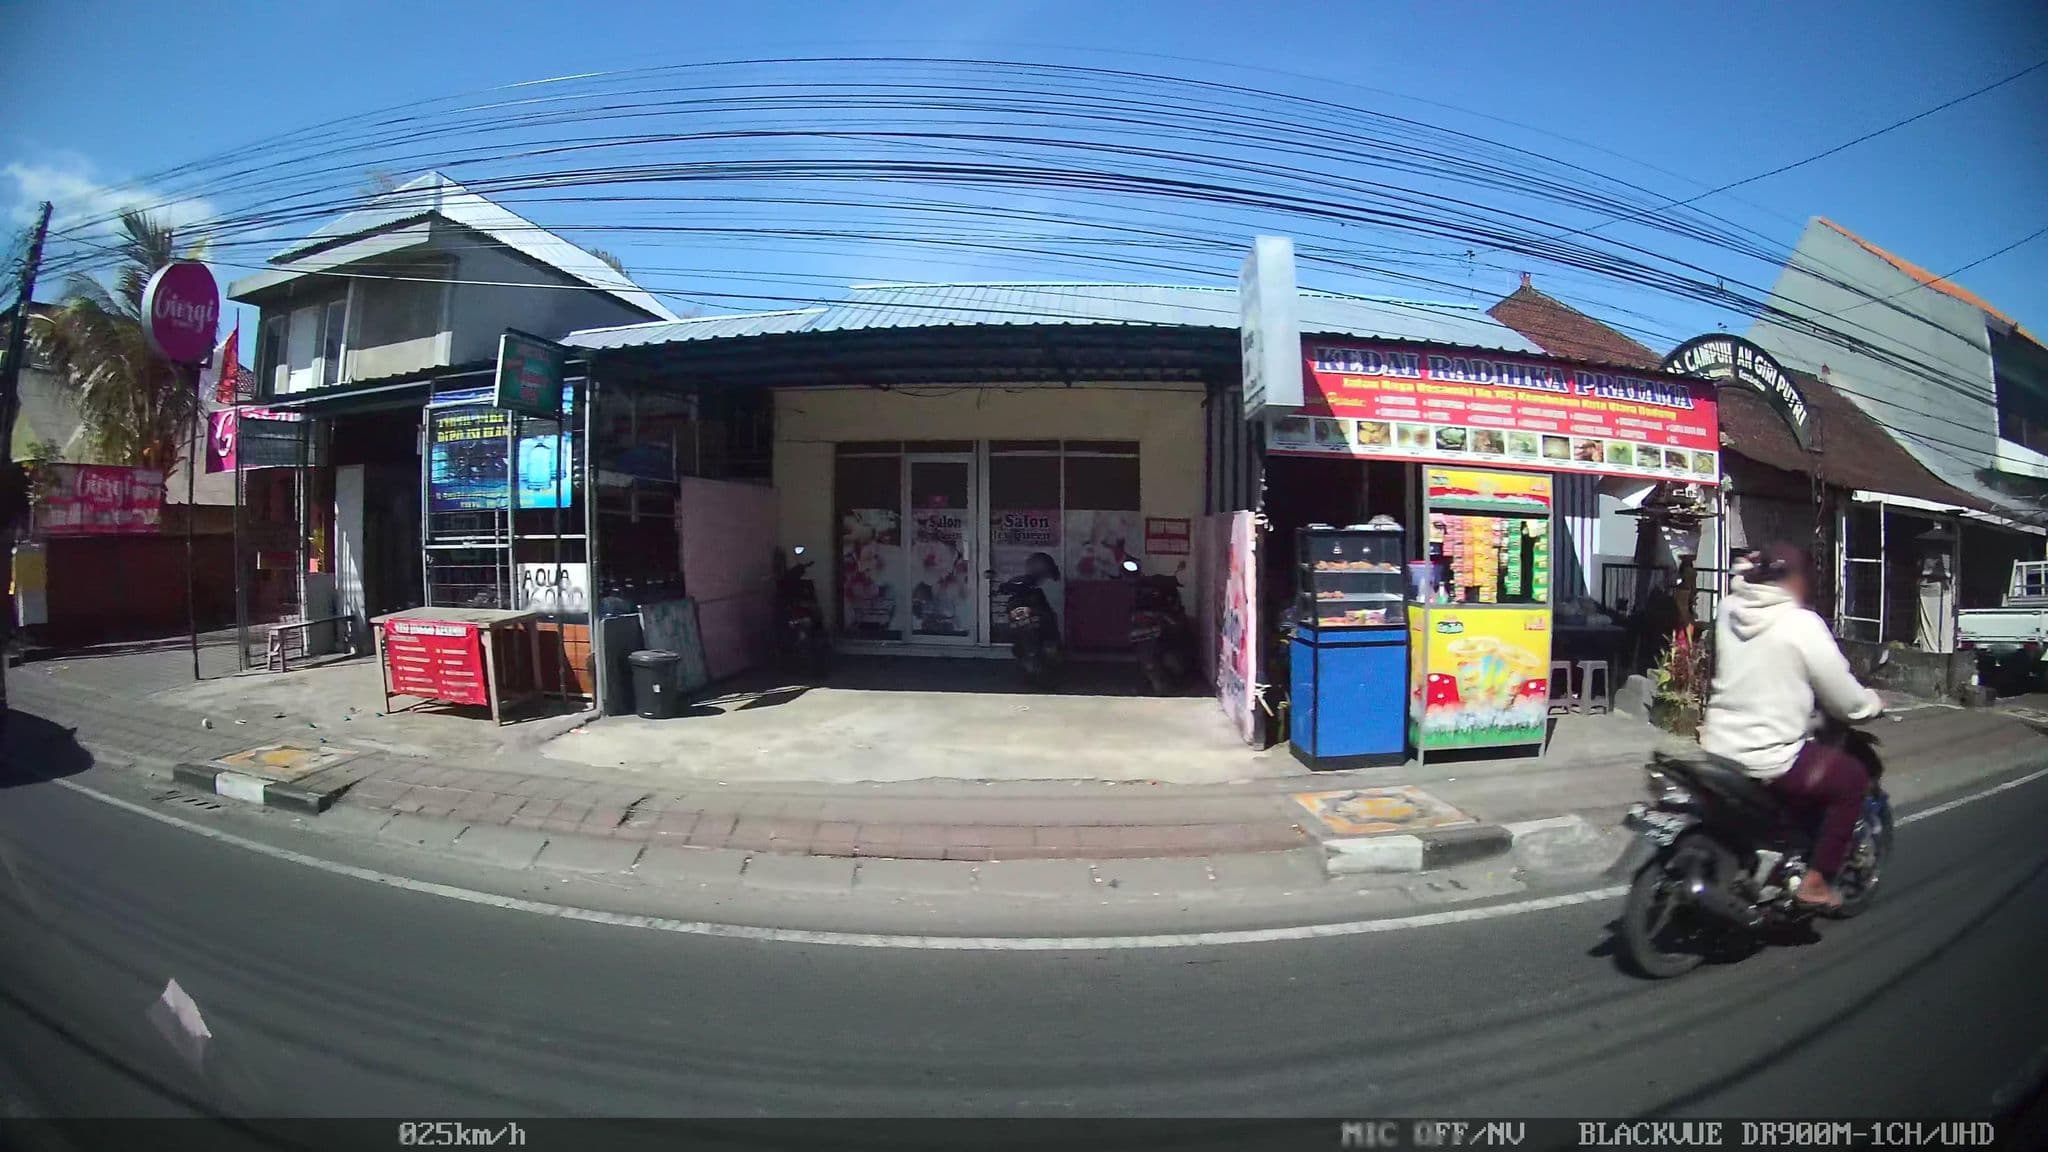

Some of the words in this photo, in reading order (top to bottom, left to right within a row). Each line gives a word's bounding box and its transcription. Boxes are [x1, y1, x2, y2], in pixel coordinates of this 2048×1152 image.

[1314, 346, 1421, 380] KEDAI
[1427, 354, 1571, 393] RADHIKA
[1574, 369, 1694, 410] PRATAMA
[1754, 355, 1777, 386] GIRI
[1003, 514, 1049, 528] Salon
